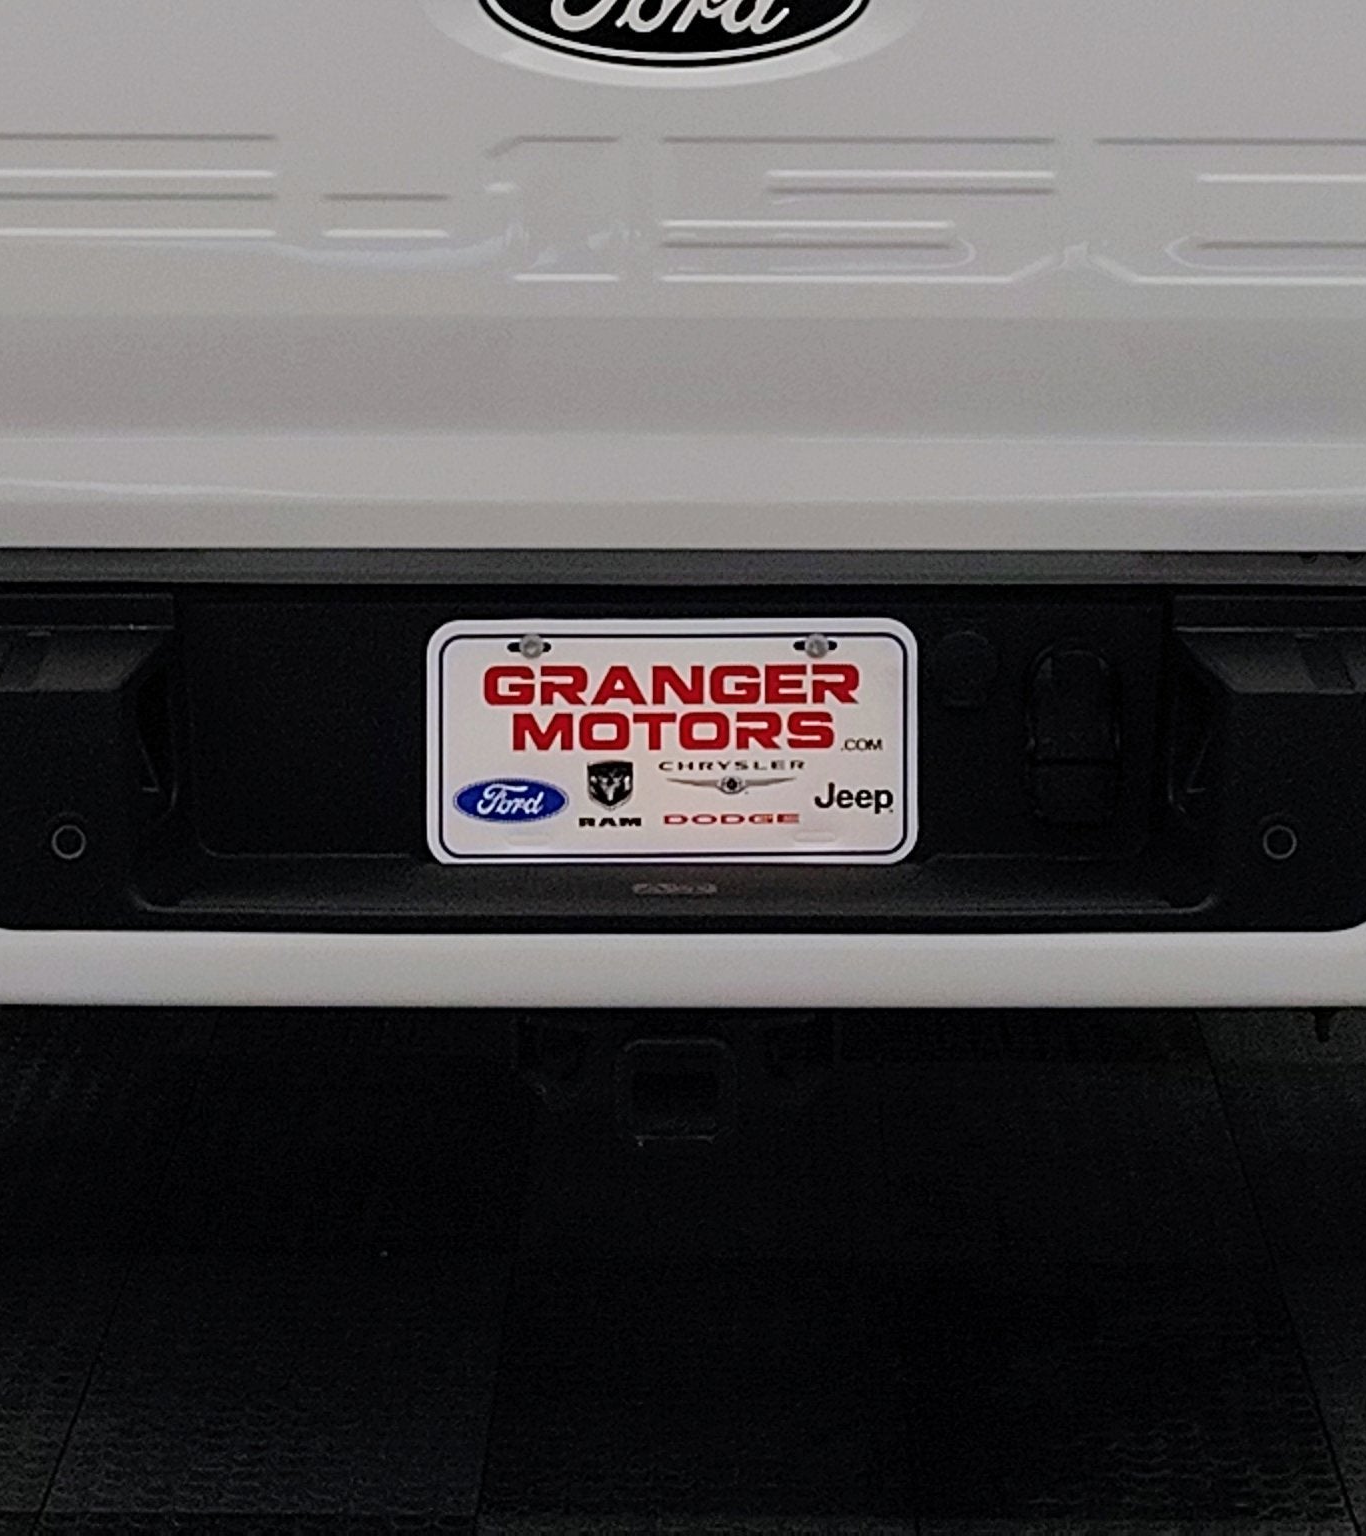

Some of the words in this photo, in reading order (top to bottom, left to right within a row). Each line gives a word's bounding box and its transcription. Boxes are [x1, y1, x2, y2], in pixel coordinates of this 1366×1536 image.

[483, 663, 860, 706] GRANGER
[511, 710, 834, 752] MOTORS
[658, 759, 806, 772] CHRYSLER
[476, 783, 545, 816] Ford
[814, 781, 894, 814] Jeep
[578, 816, 642, 827] RAM
[663, 813, 801, 825] DODGE
